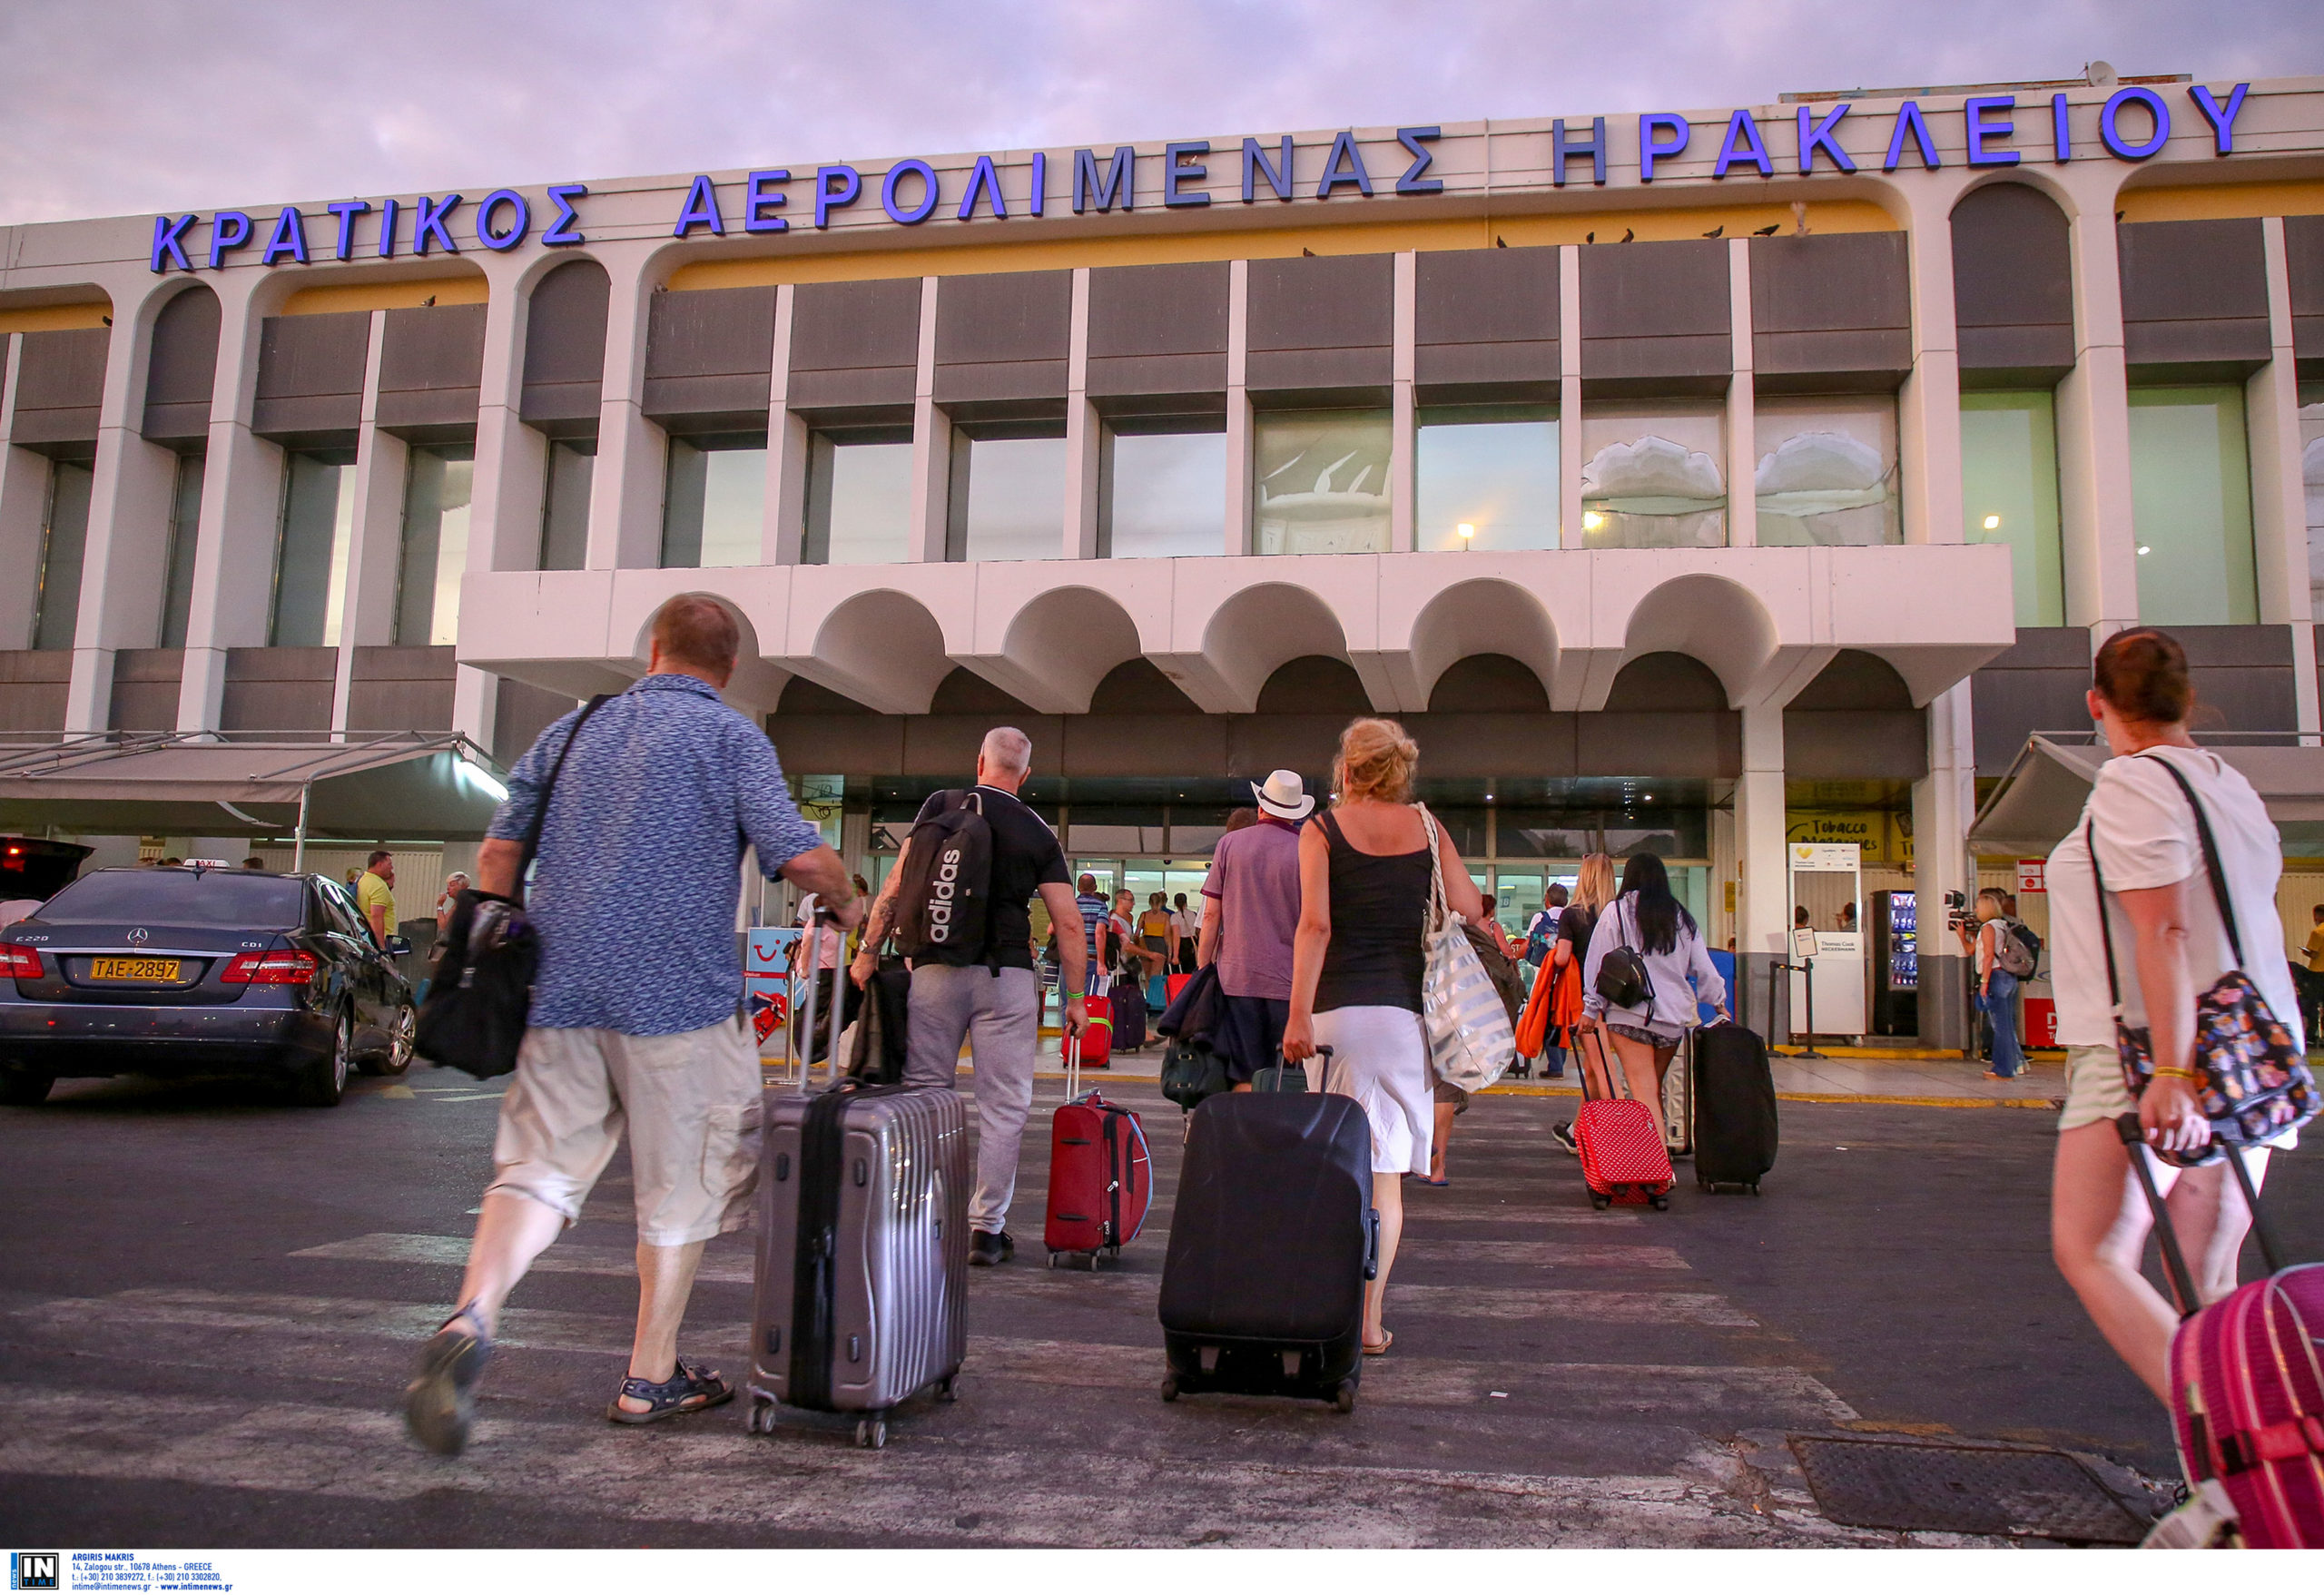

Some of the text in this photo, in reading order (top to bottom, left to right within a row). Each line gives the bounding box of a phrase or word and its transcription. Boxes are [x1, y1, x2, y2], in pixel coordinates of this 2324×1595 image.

[150, 82, 2251, 274] ΚΡΑΤΙΚΟΣ ΑΕΡΟΛΙΜΕΝΑΣ ΗΡΑΚΛΕΙΟΥ
[1812, 820, 1867, 834] Tobacco
[928, 849, 960, 943] adidas
[96, 960, 177, 979] TAE-2897
